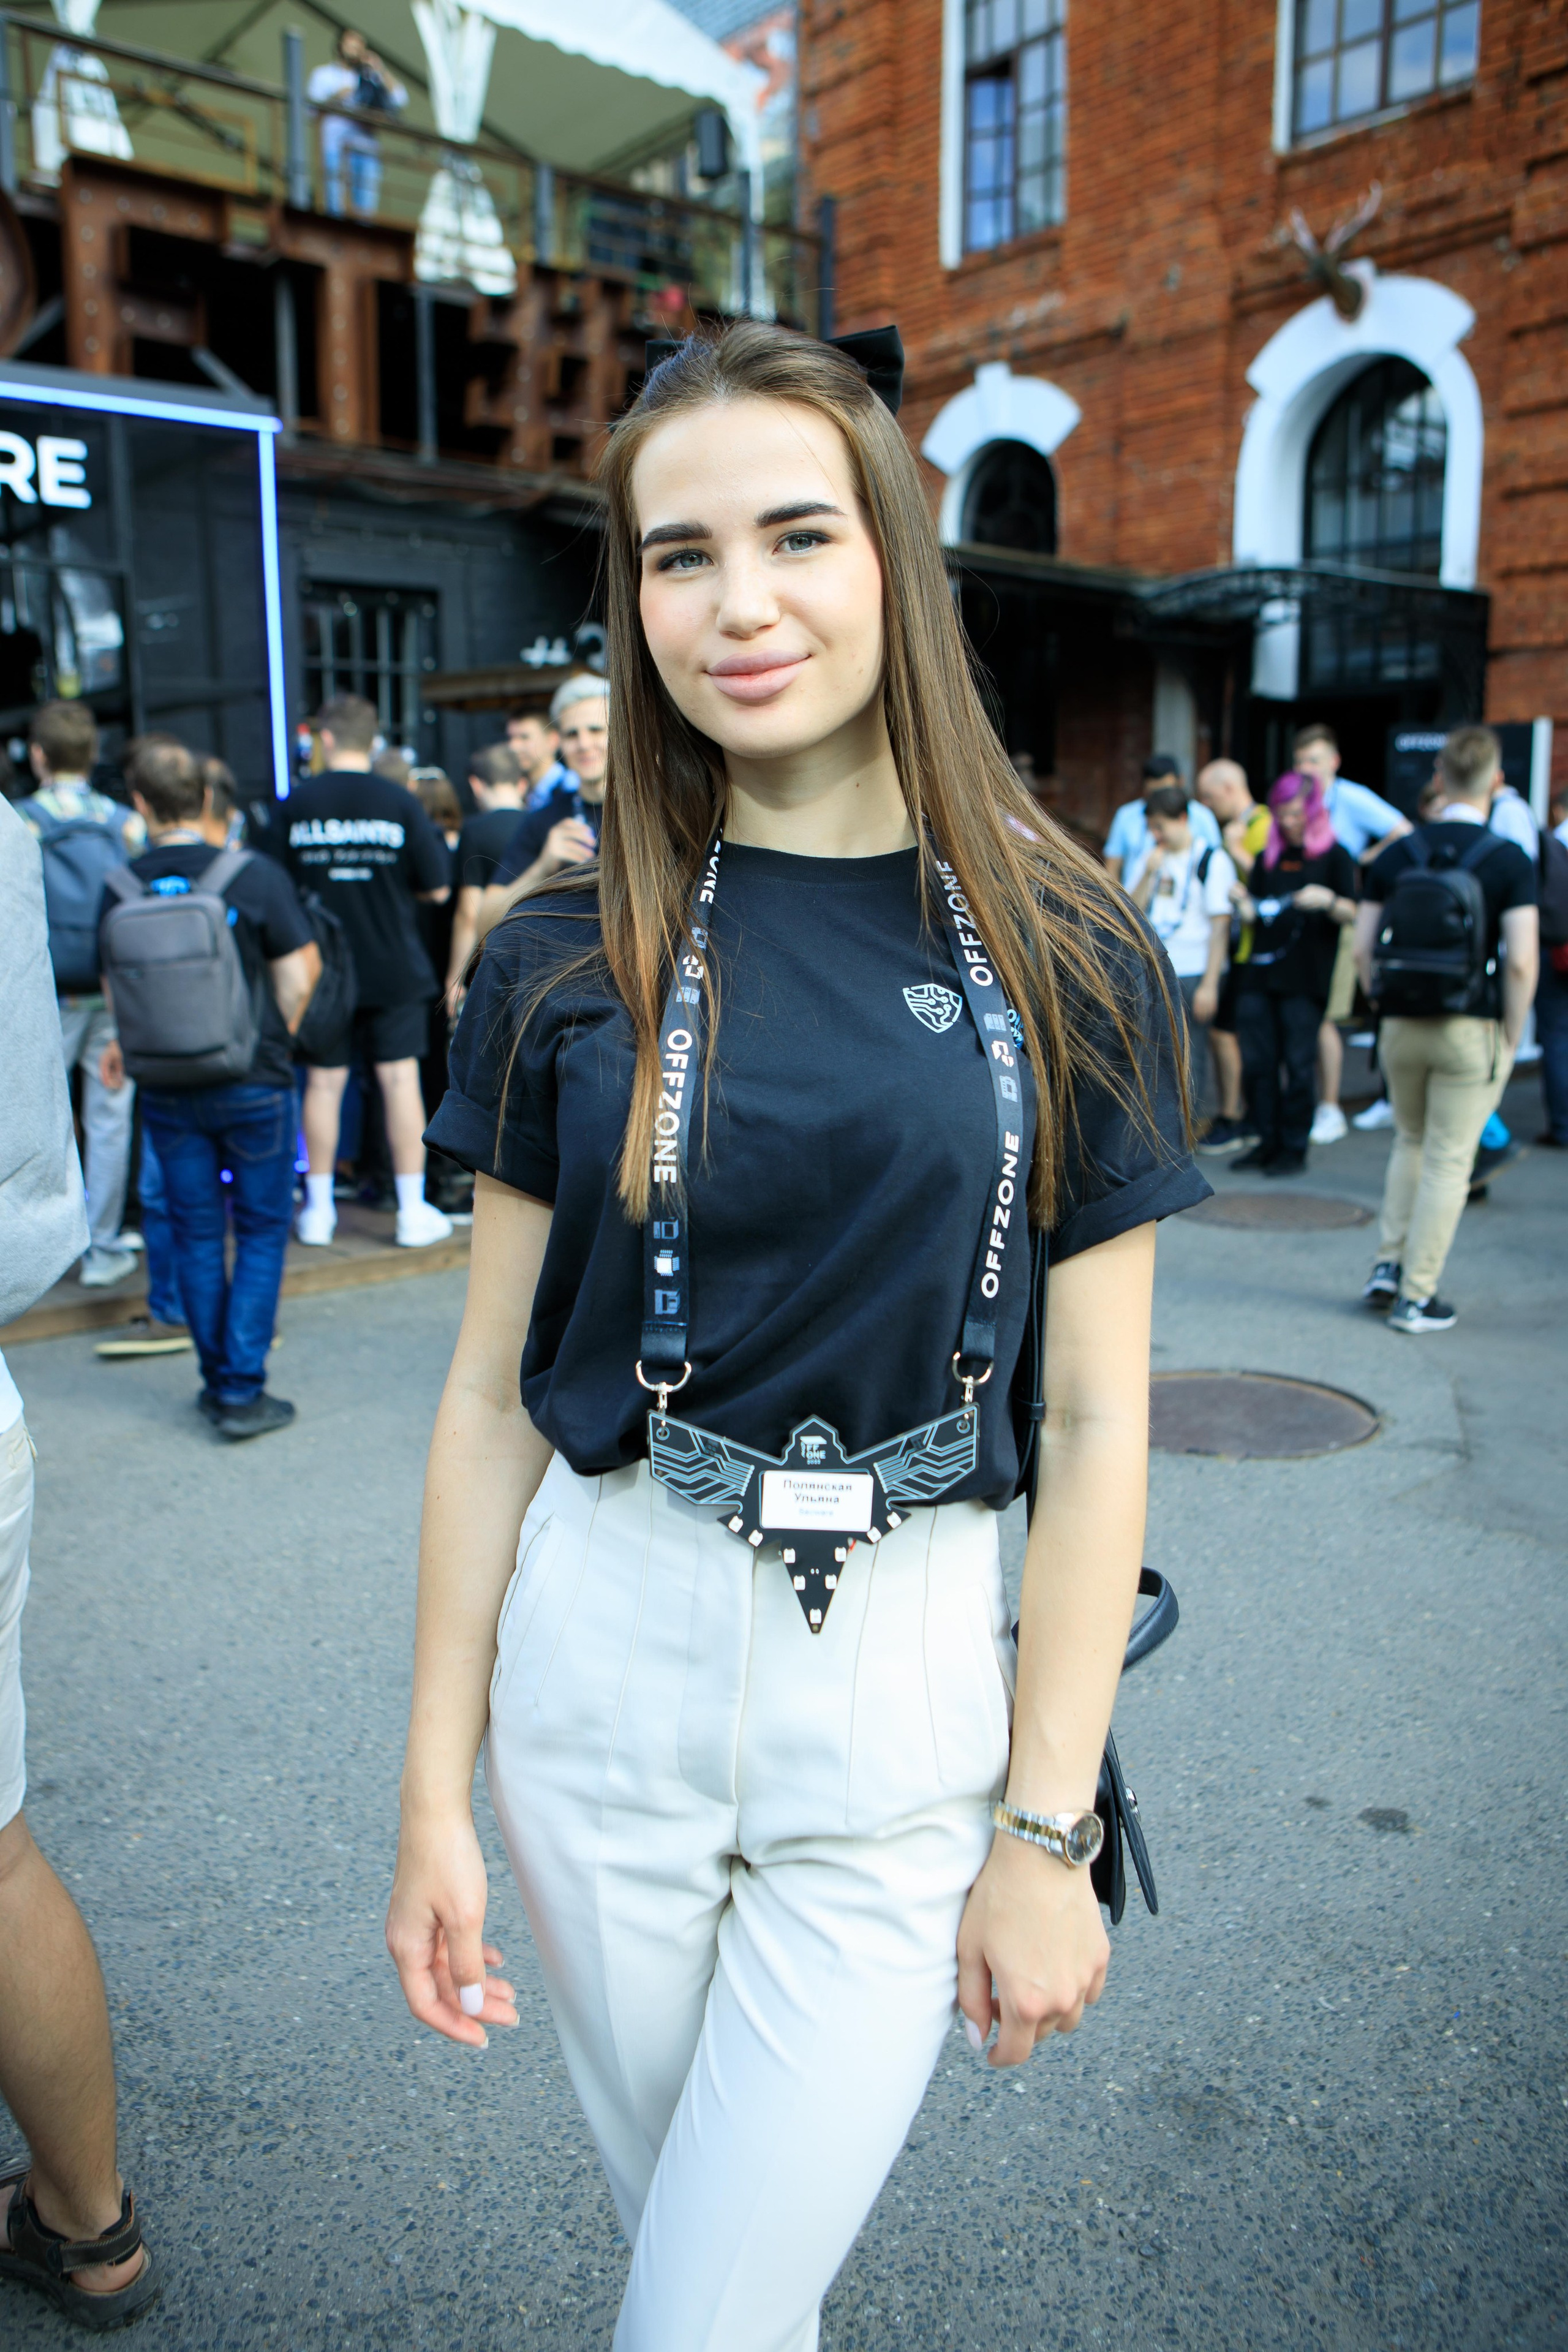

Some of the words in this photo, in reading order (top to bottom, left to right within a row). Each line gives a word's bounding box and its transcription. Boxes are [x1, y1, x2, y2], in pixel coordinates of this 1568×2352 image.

[654, 1029, 693, 1183] OFFZONE
[981, 1131, 1019, 1298] OFFZONE
[783, 1479, 853, 1491] Полянская
[795, 1493, 840, 1503] Ульяна
